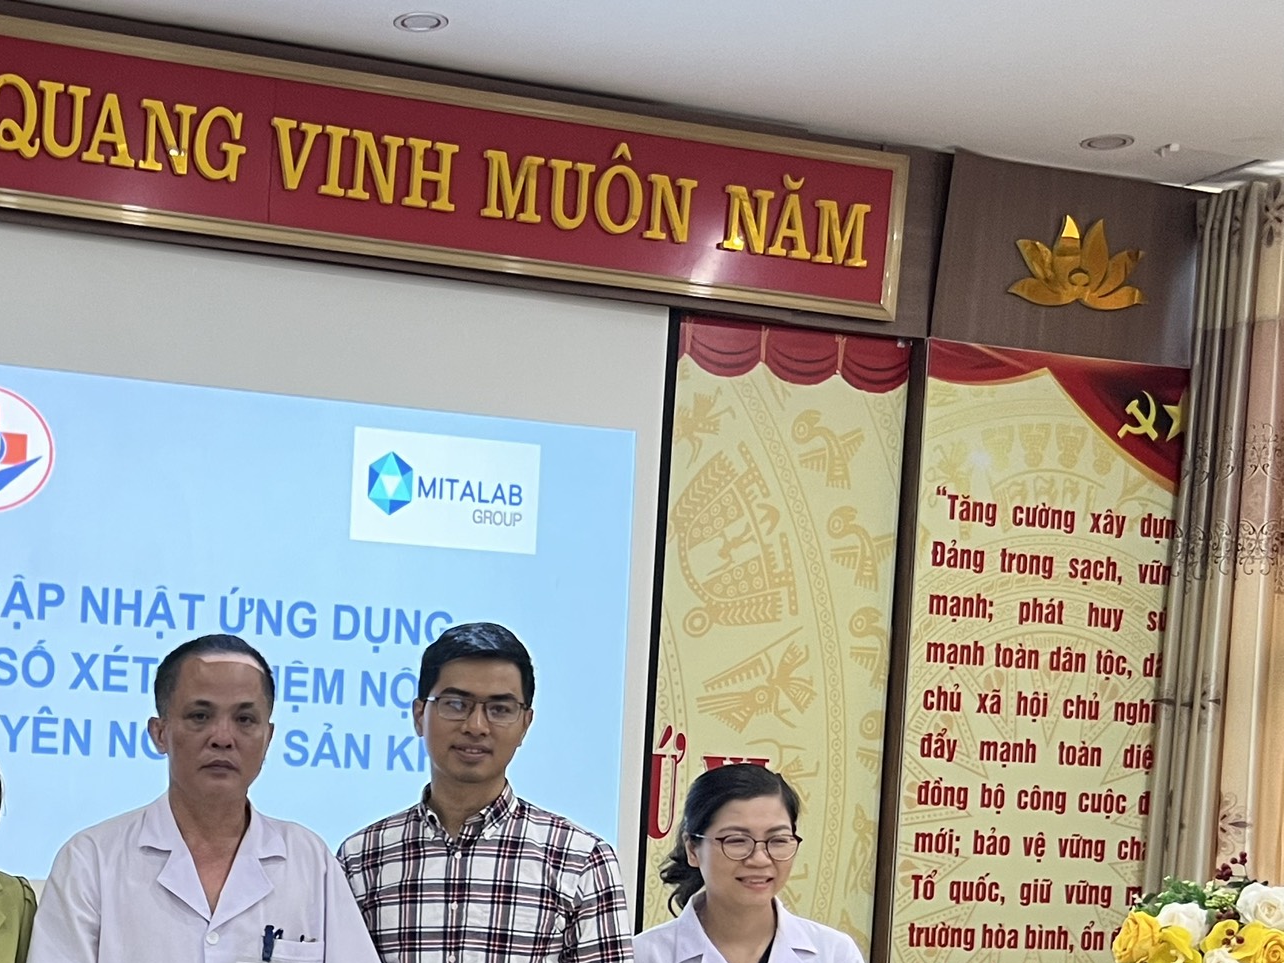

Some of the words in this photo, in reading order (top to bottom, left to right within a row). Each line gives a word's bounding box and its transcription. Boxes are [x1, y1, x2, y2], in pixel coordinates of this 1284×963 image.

[270, 116, 459, 213] VINH
[480, 142, 699, 244] MUÔN
[716, 174, 872, 268] NĂM
[418, 475, 523, 506] MITALAB
[472, 509, 523, 527] GROUP
[1012, 502, 1076, 534] cường
[1089, 509, 1126, 539] xây
[931, 540, 985, 573] Đảng
[1000, 548, 1054, 579] trong
[1069, 556, 1123, 585] sạch,
[80, 585, 205, 640] NHẬT
[219, 586, 317, 639] ỨNG
[928, 593, 994, 623] mạnh;
[1018, 598, 1064, 625] phát
[1087, 602, 1124, 632] huy
[926, 640, 985, 670] mạnh
[995, 642, 1039, 670] toàn
[1049, 646, 1086, 673] dân
[1096, 649, 1132, 680] tộc,
[69, 645, 159, 694] XÉT
[359, 667, 417, 719] NỘ
[923, 683, 961, 712] chủ
[976, 690, 1002, 714] xã
[1016, 691, 1048, 722] hội
[1063, 692, 1100, 720] chủ
[283, 723, 370, 770] SẢN
[920, 728, 957, 762] đẩy
[979, 738, 1037, 768] mạnh
[1058, 740, 1102, 767] toàn
[917, 777, 968, 811] đồng
[980, 783, 1005, 814] bộ
[1017, 785, 1067, 814] công
[1078, 788, 1127, 819] cuộc
[914, 827, 961, 857] mới;
[972, 827, 1010, 856] bảo
[1023, 832, 1046, 862] vệ
[1058, 833, 1106, 862] vững
[911, 869, 938, 900] Tổ
[949, 873, 1005, 905] quốc,
[1019, 878, 1053, 906] giữ
[1065, 880, 1112, 908] vững
[908, 922, 975, 950] trường
[981, 923, 1017, 949] hòa
[1024, 924, 1074, 953] bình,
[1081, 920, 1105, 950] ổn
